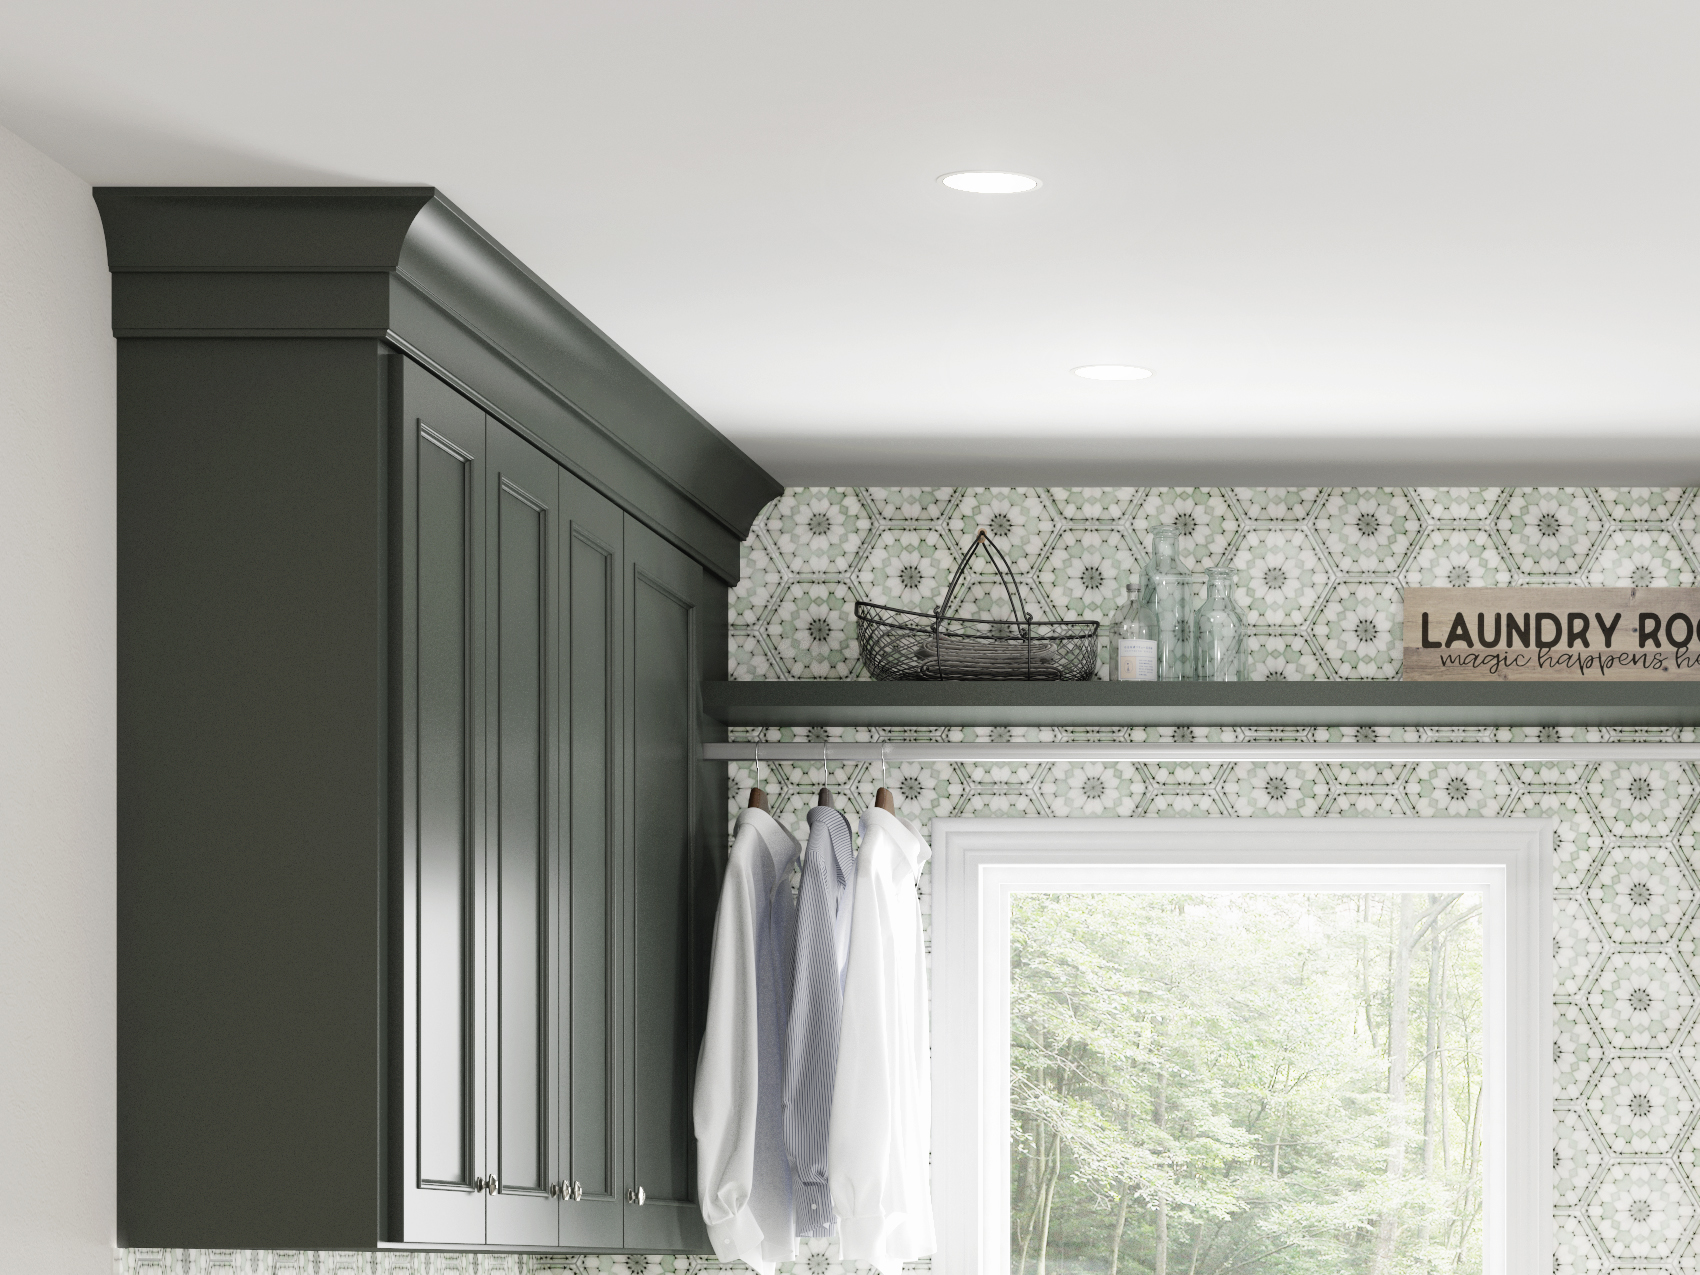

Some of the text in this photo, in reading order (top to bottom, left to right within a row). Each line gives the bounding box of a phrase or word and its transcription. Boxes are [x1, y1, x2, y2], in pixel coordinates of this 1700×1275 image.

[1421, 611, 1622, 649] LAUNDRY
[1440, 650, 1531, 674] magic
[1537, 647, 1668, 676] happens
